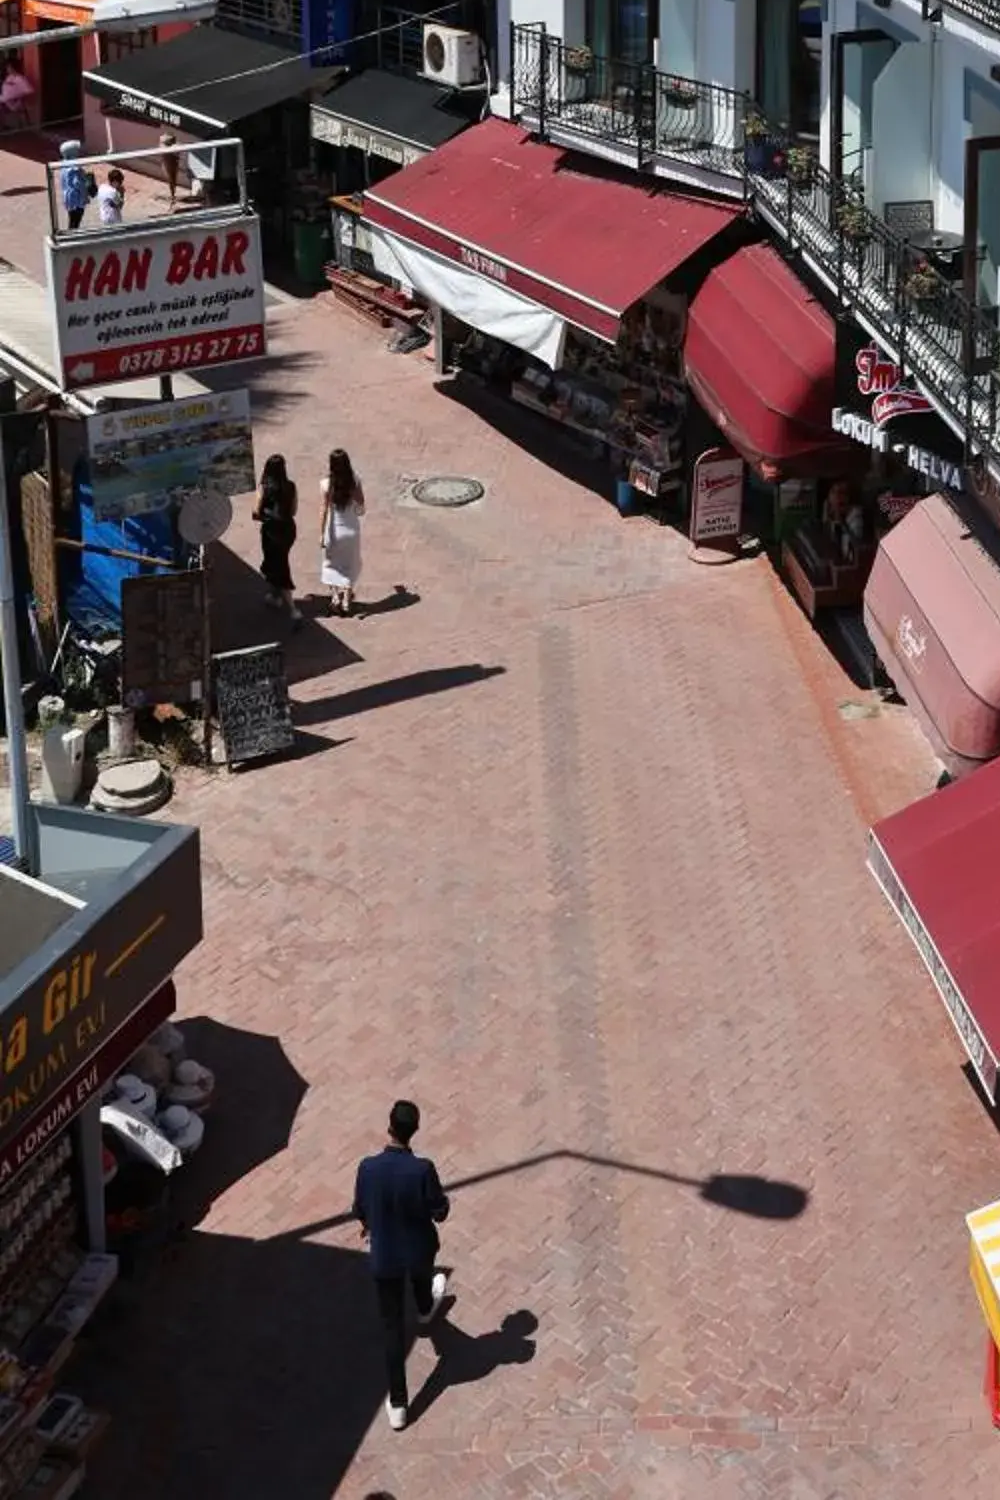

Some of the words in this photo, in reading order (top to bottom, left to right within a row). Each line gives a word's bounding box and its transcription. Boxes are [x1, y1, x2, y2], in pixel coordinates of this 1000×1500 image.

[65, 246, 152, 301] HAN
[165, 231, 249, 286] BAR
[67, 313, 90, 329] Her
[93, 308, 122, 326] gece
[160, 295, 197, 312] müzik
[167, 315, 187, 332] tek
[191, 307, 230, 326] adresi
[119, 348, 166, 373] 0378
[168, 341, 203, 364] 315
[207, 334, 232, 359] 27
[832, 406, 888, 452] LOKUM
[908, 445, 962, 491] HELVA
[0, 1014, 28, 1074] a
[43, 950, 98, 1036] Gir
[16, 1094, 73, 1164] LOKUM
